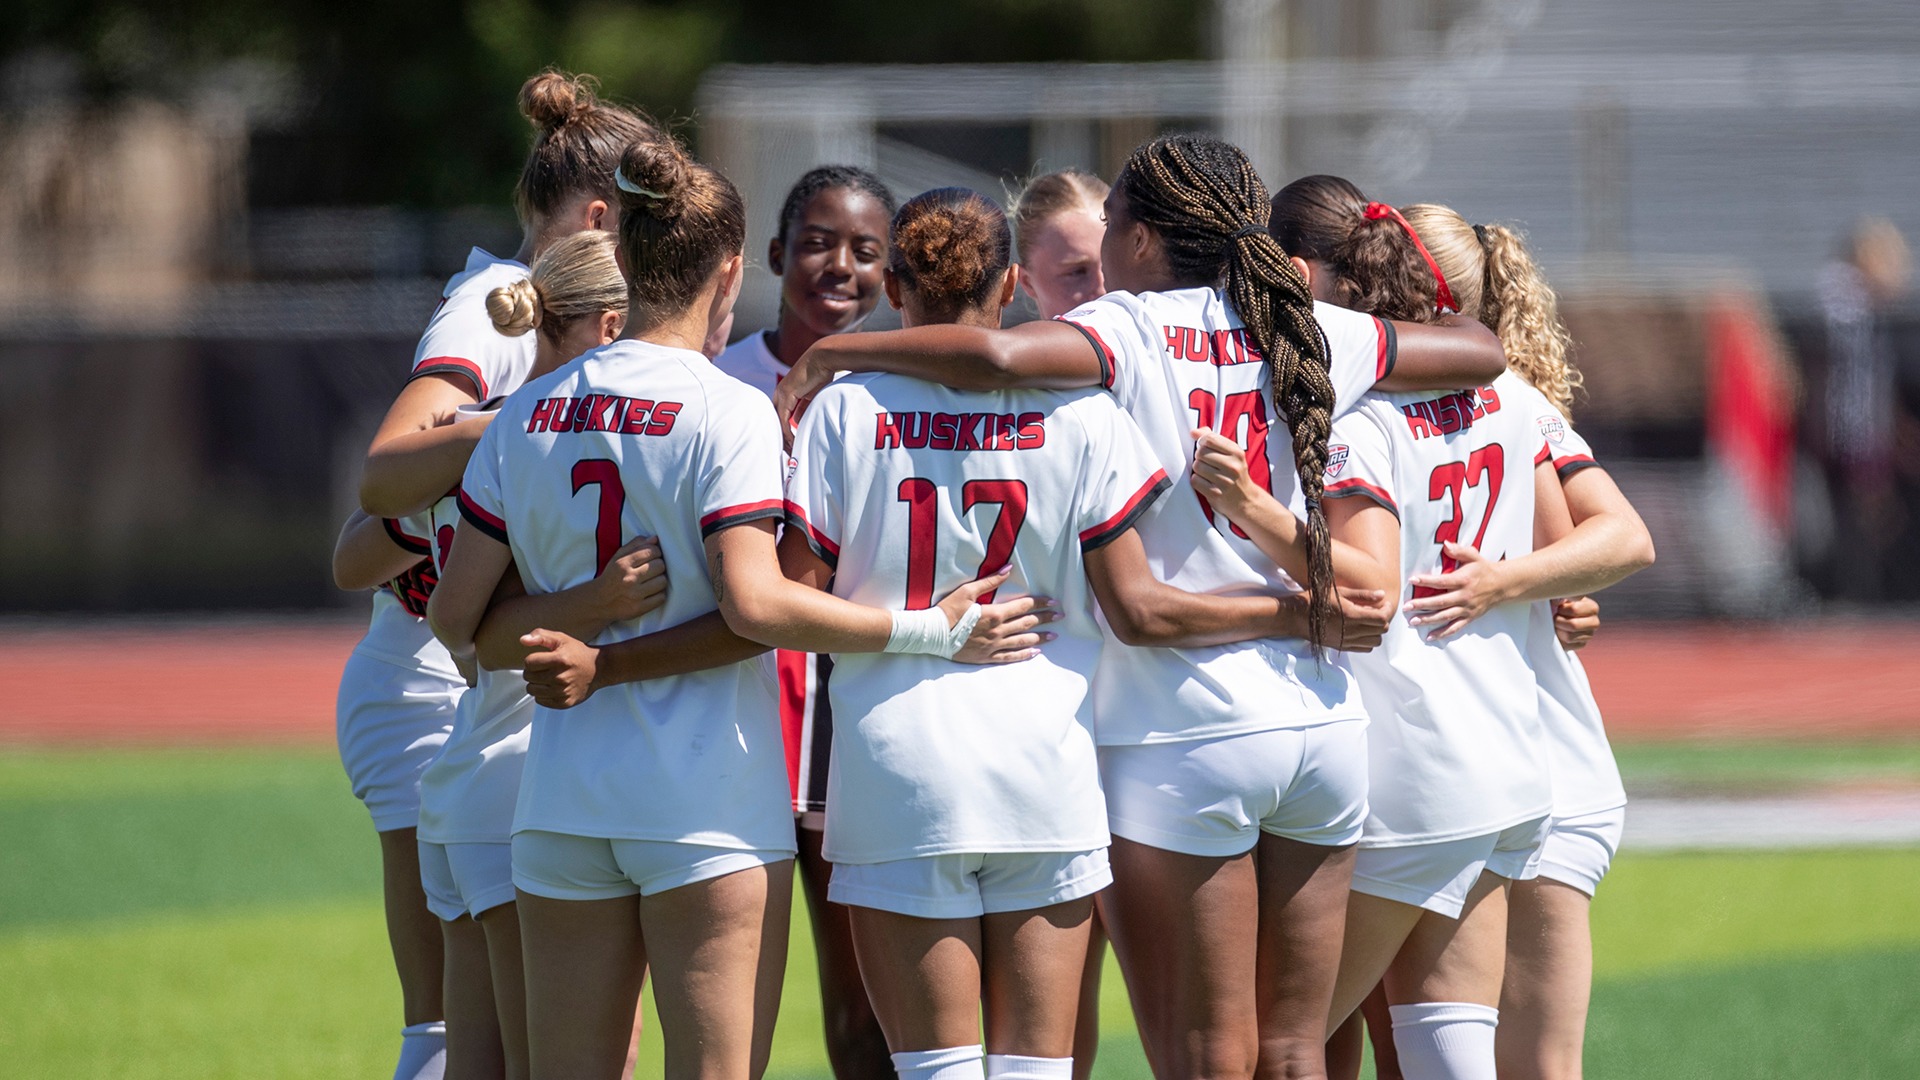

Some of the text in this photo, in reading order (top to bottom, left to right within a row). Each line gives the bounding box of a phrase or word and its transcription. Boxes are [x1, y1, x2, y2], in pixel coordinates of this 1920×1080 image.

[1163, 325, 1263, 366] HUKIE
[526, 393, 683, 436] HUSKIES
[875, 411, 1045, 451] HUSKIES
[1401, 384, 1501, 440] HUSKS
[571, 458, 625, 580] 7
[897, 477, 1028, 611] 17
